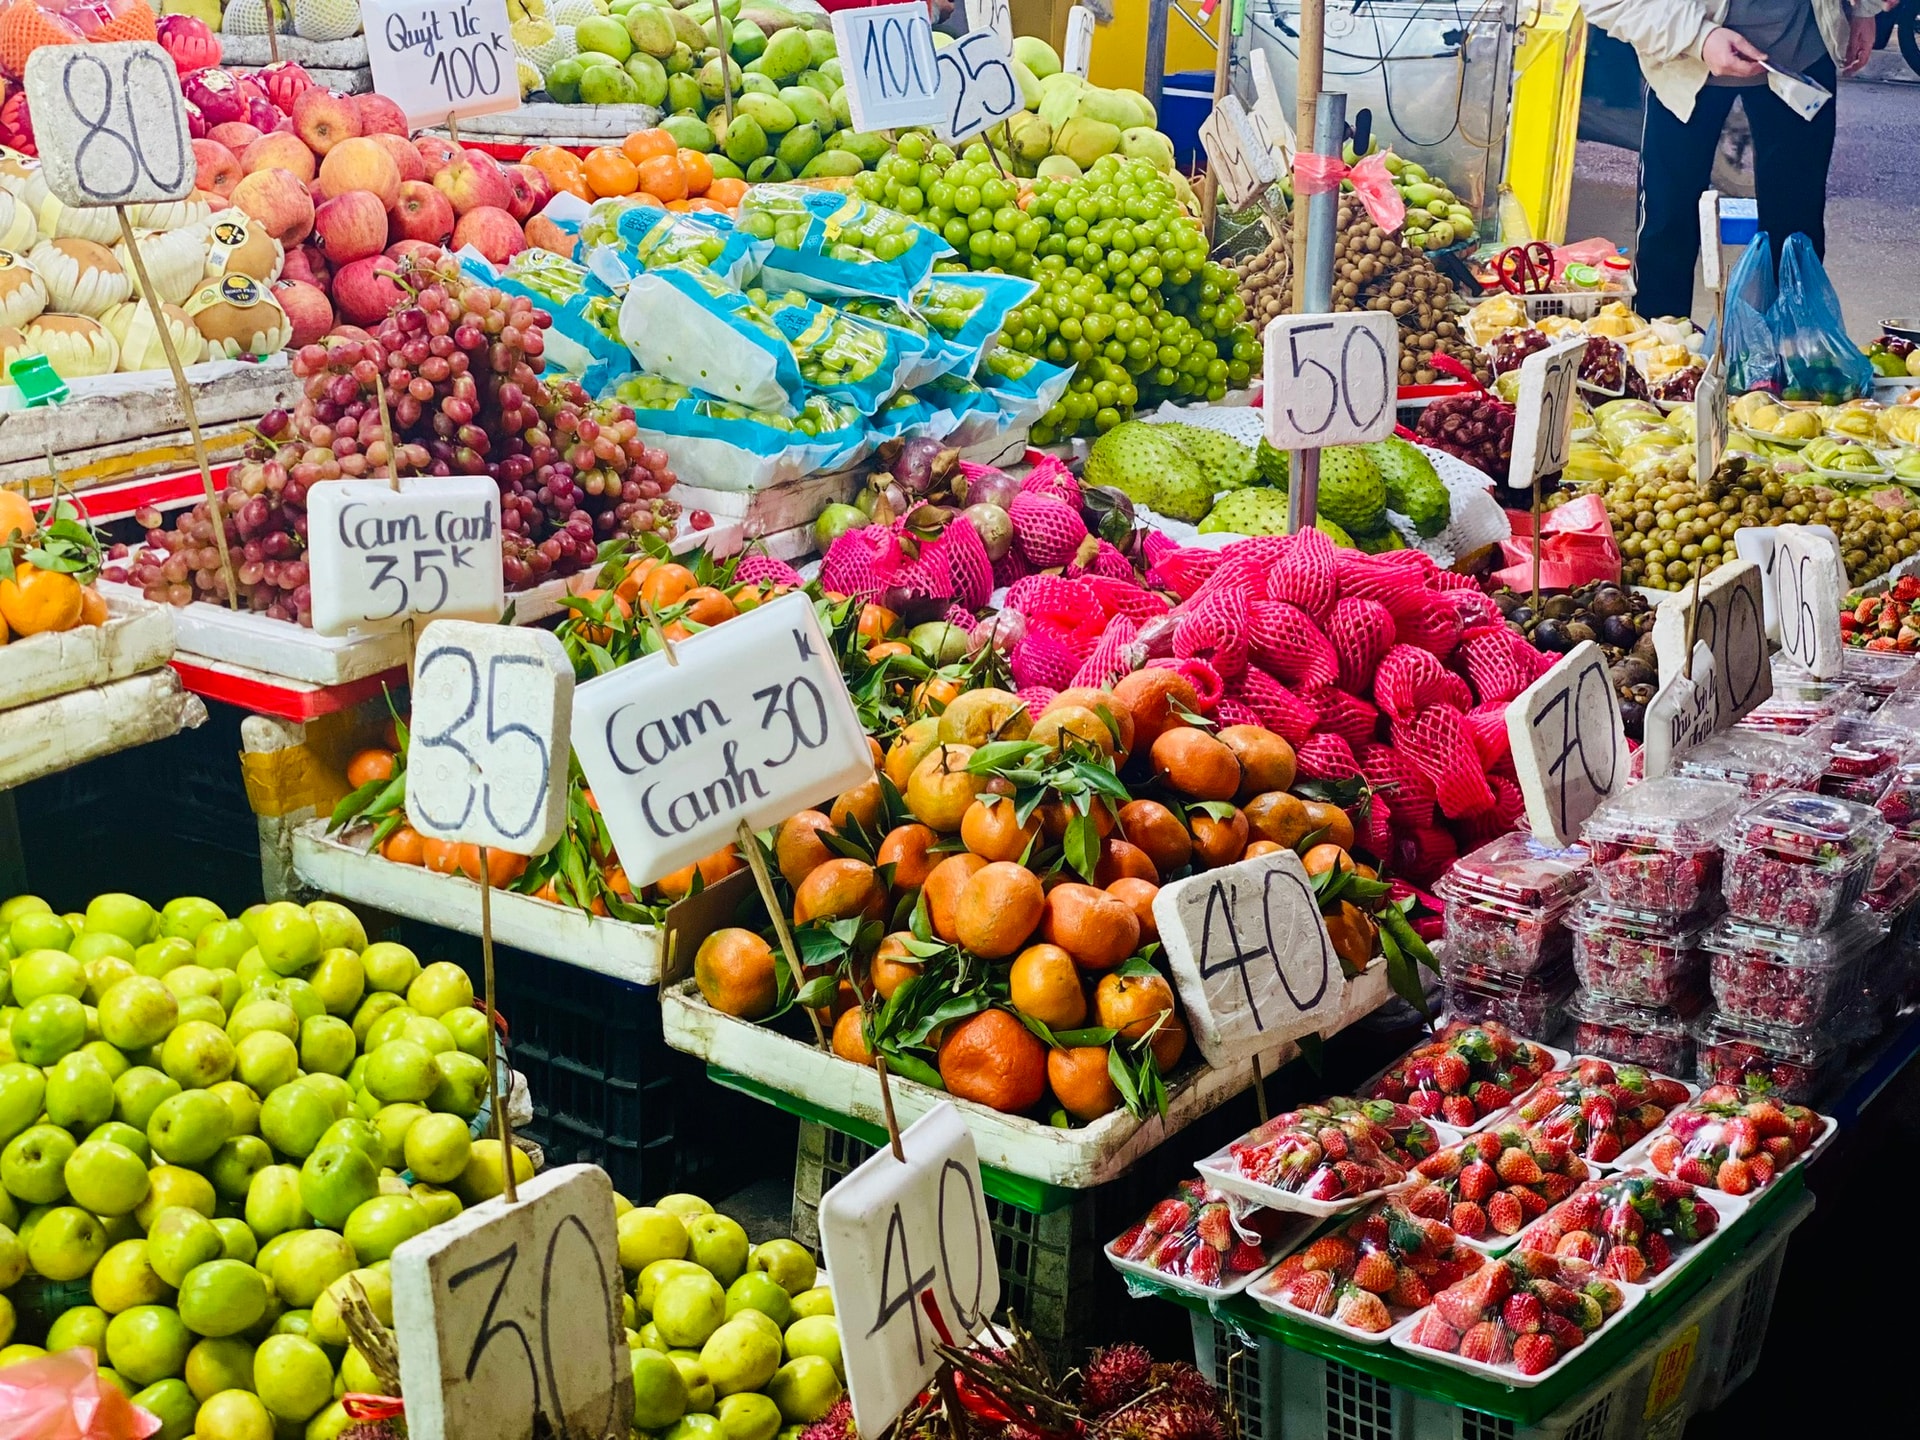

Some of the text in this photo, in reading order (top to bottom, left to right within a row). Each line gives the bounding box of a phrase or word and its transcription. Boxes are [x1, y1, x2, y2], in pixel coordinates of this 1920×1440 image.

[863, 16, 941, 99] 100
[935, 32, 1016, 138] 25
[63, 49, 184, 199] 80
[1288, 321, 1389, 435] 50
[338, 502, 428, 550] Cam
[412, 646, 552, 839] 35
[605, 698, 732, 775] Cam
[640, 739, 771, 838] Canh
[1533, 661, 1617, 837] 70
[1200, 869, 1328, 1032] 40
[448, 1214, 616, 1440] 30
[866, 1158, 983, 1367] 40
